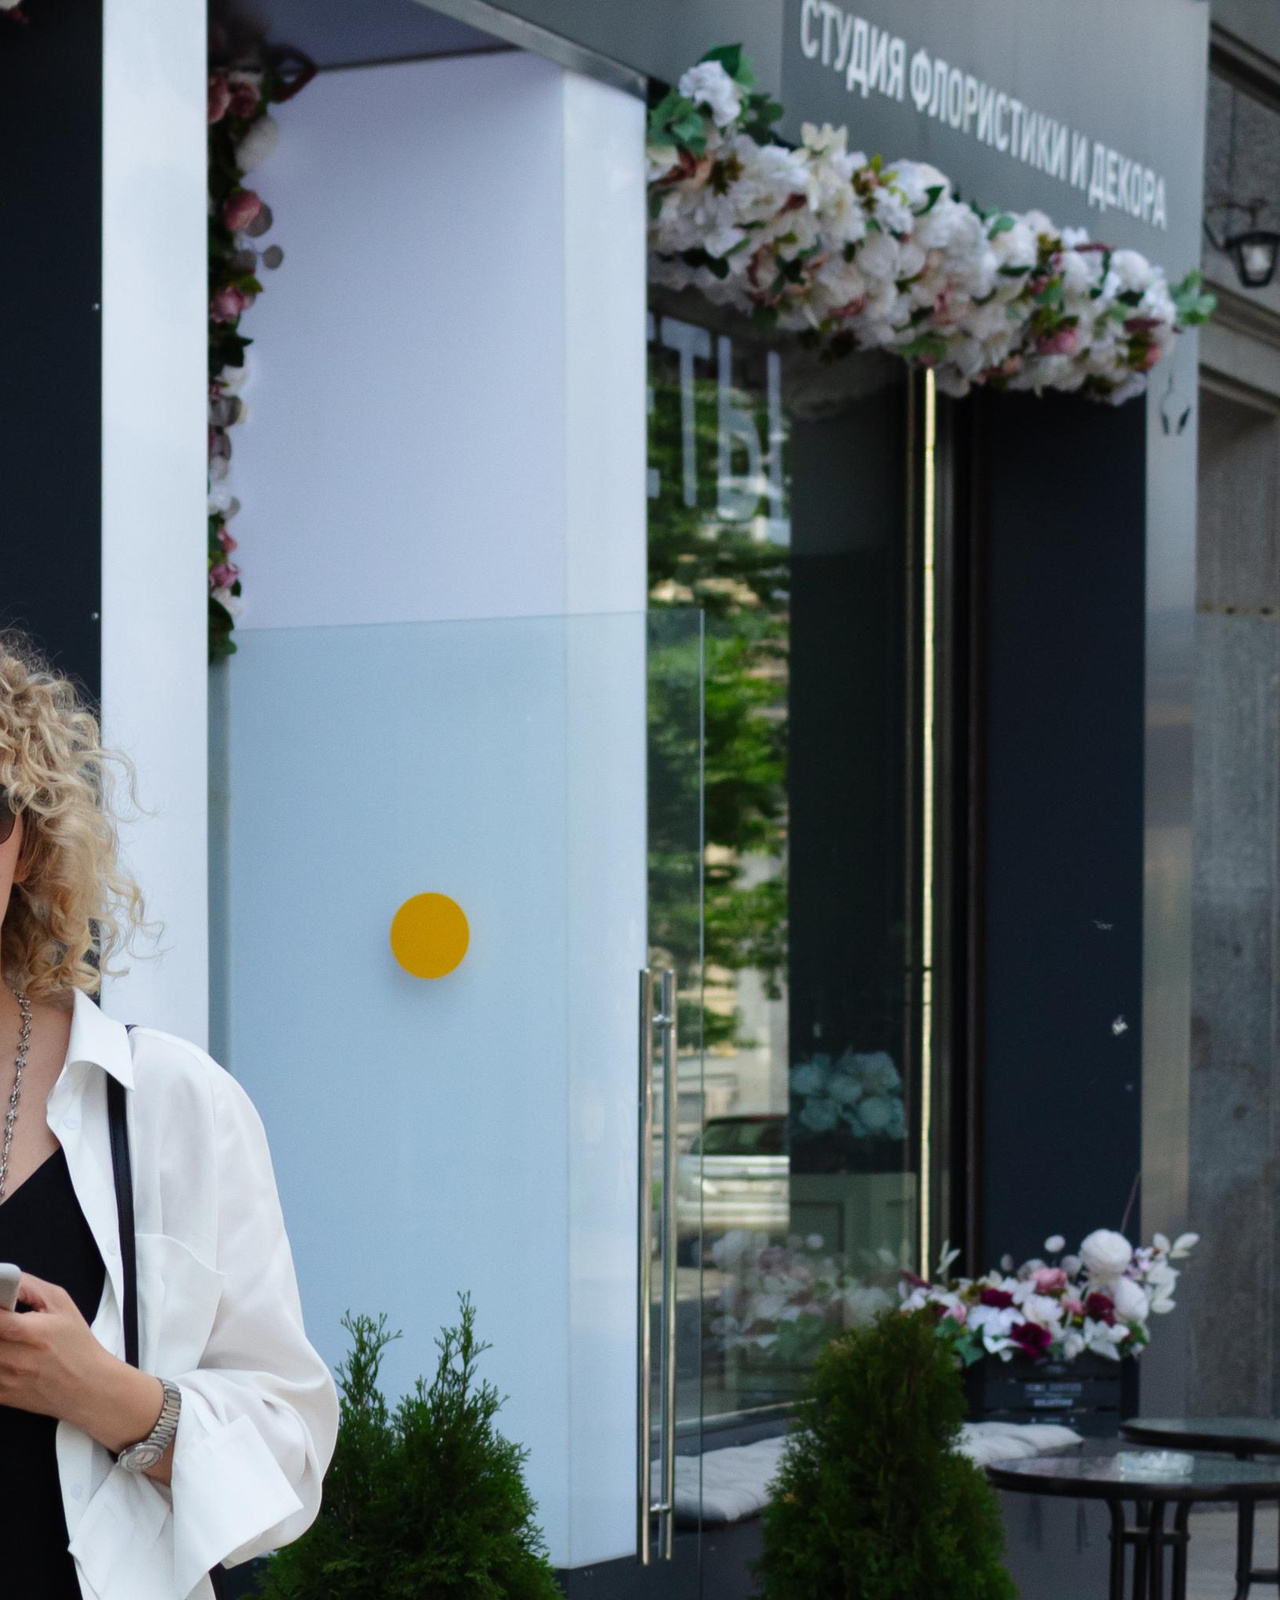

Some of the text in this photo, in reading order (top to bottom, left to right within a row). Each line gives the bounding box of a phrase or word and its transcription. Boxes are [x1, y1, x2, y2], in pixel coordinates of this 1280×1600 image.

[801, 0, 1167, 231] СТУДИЯ ФЛОРИСТИКИ И ДЕКОРА
[648, 311, 784, 522] ТЫ
